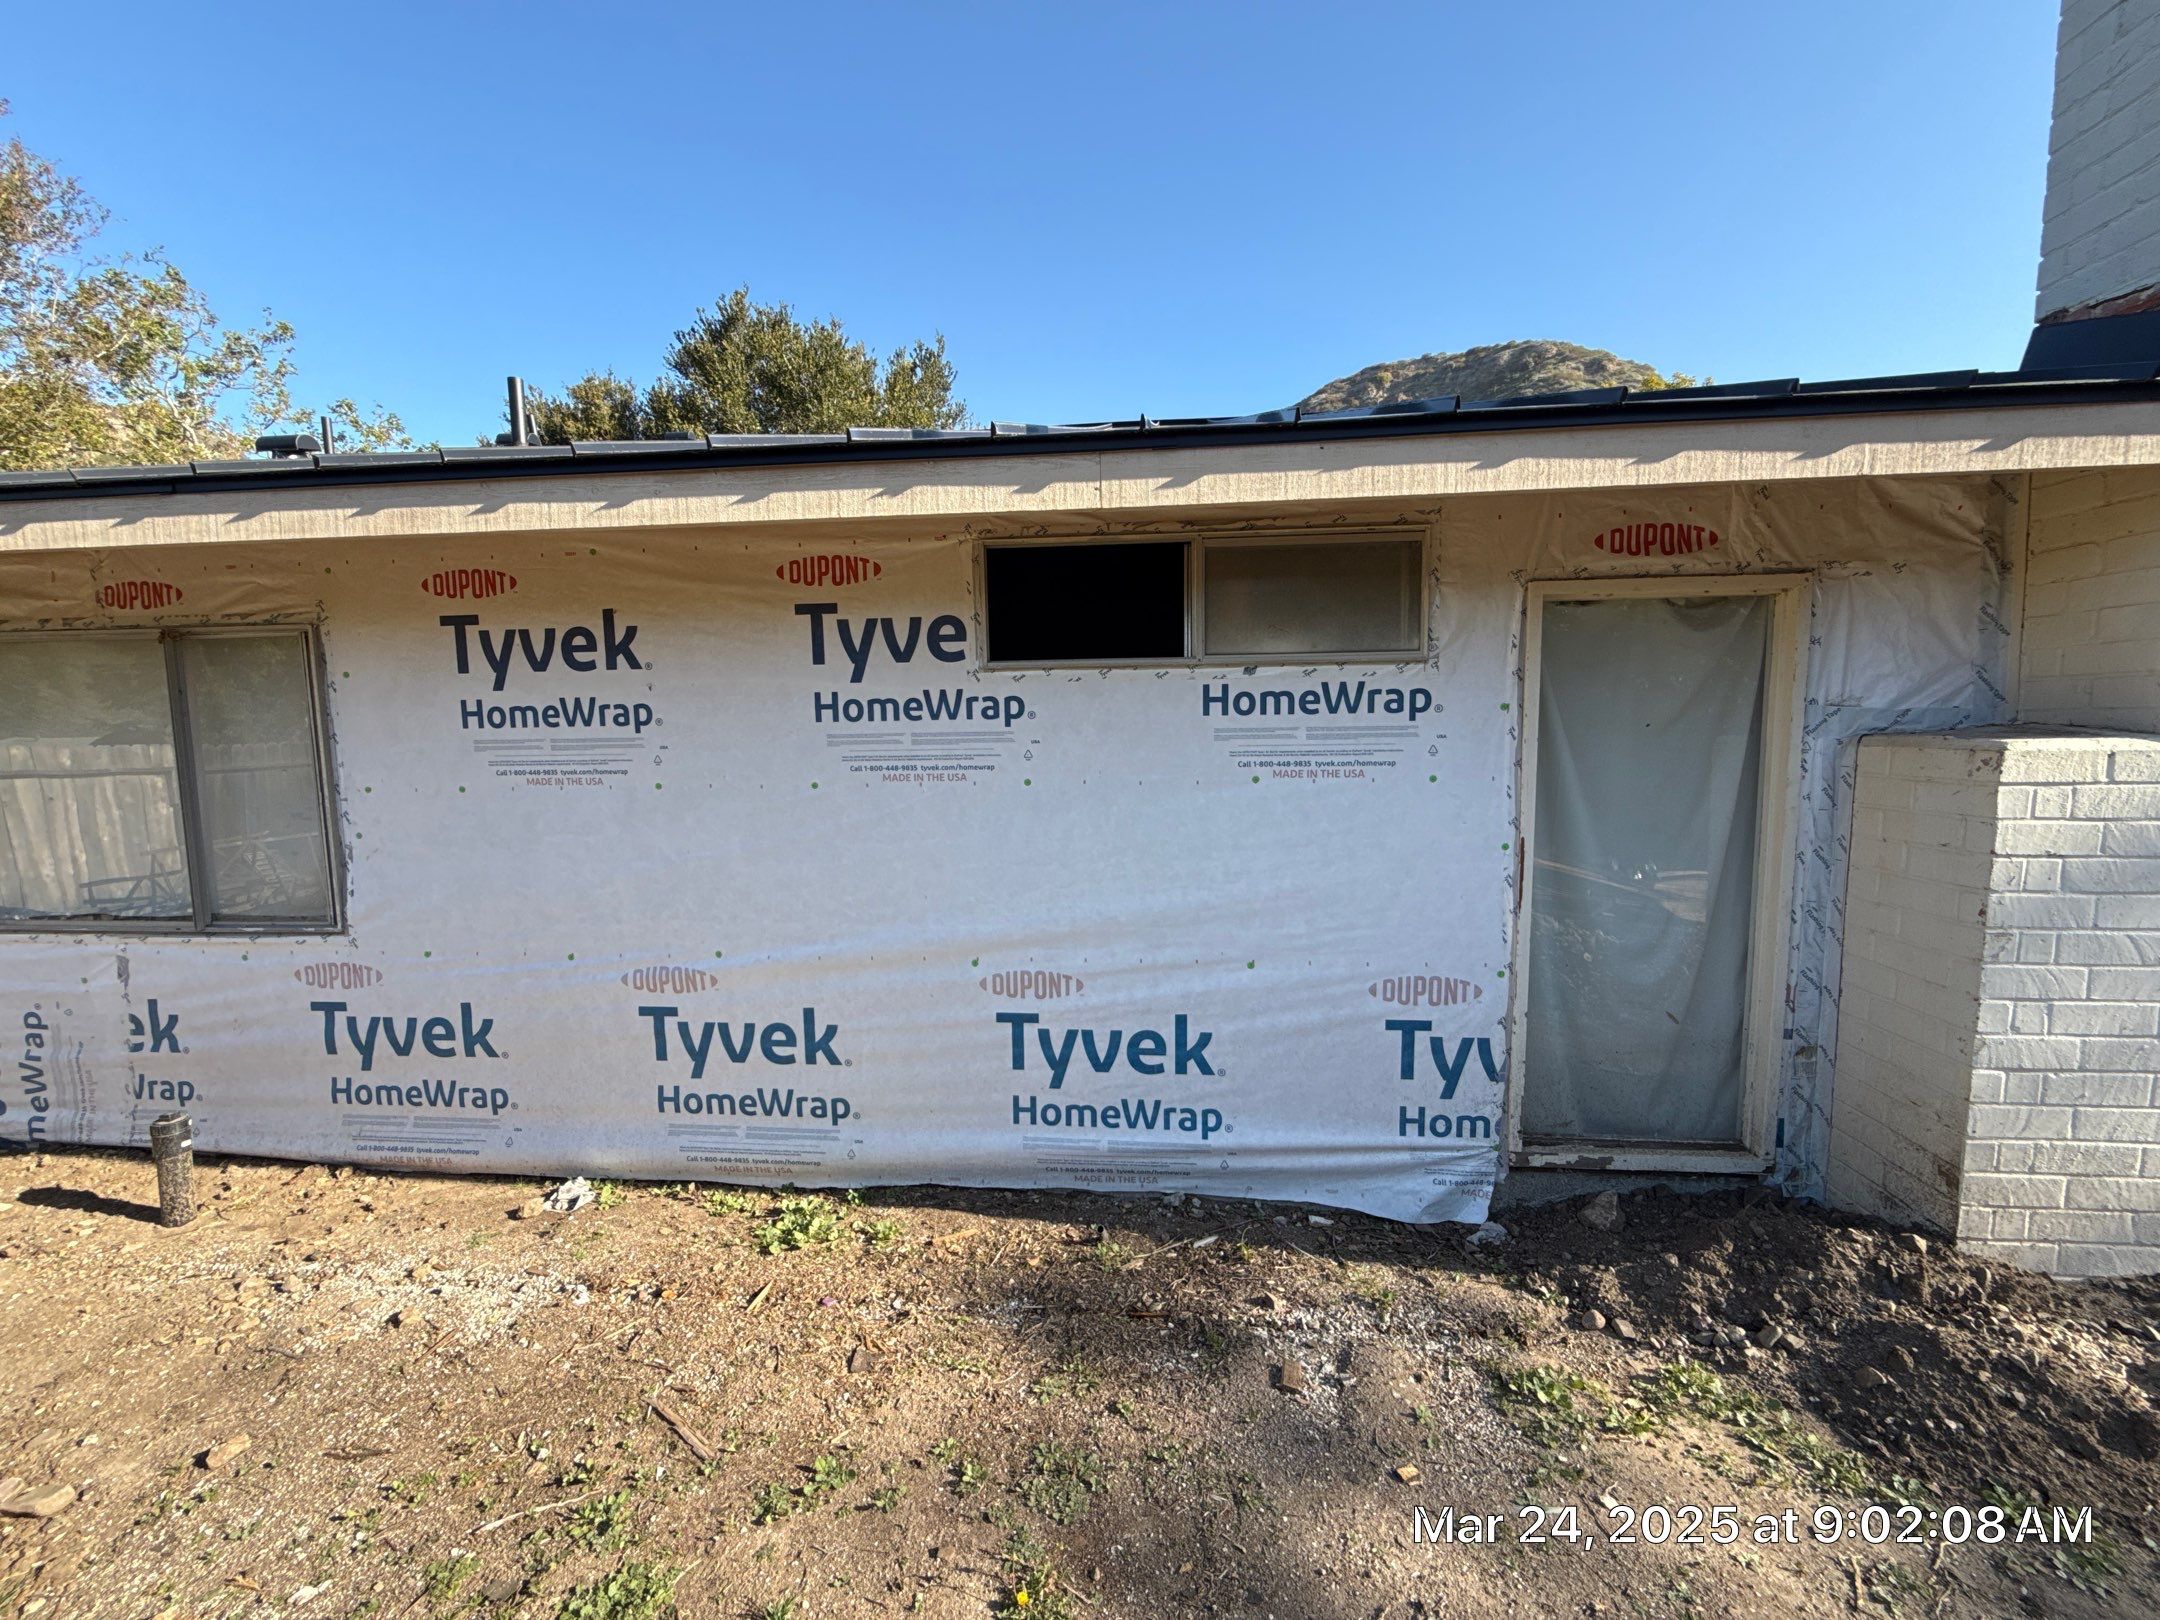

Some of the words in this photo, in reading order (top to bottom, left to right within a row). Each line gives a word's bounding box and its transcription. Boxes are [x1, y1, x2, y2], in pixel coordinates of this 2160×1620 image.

[1610, 522, 1705, 556] DUPONT
[432, 568, 506, 599] DUPONT
[789, 554, 870, 587] DUPONT
[104, 581, 174, 611] DUPONT
[439, 608, 643, 691] Tyvek
[460, 696, 653, 733] HomeWrap
[813, 688, 1025, 727] HomeWrap
[1202, 681, 1432, 721] HomeWrap
[526, 777, 553, 786] MADE
[554, 777, 564, 786] IN
[566, 777, 584, 786] THE
[585, 777, 604, 785] USA
[882, 774, 911, 782] MADE
[913, 773, 925, 782] IN
[926, 773, 945, 782] THE
[948, 773, 967, 782] USA
[1272, 769, 1304, 778] MADE
[1307, 769, 1318, 778] IN
[1320, 769, 1341, 778] THE
[1343, 769, 1365, 778] USA
[304, 962, 374, 990] DUPONT
[632, 966, 707, 994] DUPONT
[992, 970, 1073, 999] DUPONT
[1382, 975, 1470, 1006] DUPONT
[310, 1001, 500, 1071] Tyvek
[638, 1006, 843, 1079] Tyvek
[995, 1012, 1215, 1089] Tyvek
[330, 1076, 509, 1116] HomeWrap
[657, 1085, 851, 1126] HomeWrap
[1012, 1095, 1222, 1140] HomeWrap
[379, 1156, 404, 1164] MADE
[406, 1156, 416, 1164] IN
[417, 1156, 434, 1165] THE
[435, 1157, 452, 1165] USA
[714, 1165, 742, 1173] MADE
[742, 1165, 753, 1173] IN
[754, 1166, 773, 1174] THE
[774, 1166, 793, 1175] USA
[1105, 1175, 1116, 1183] IN
[1118, 1175, 1137, 1183] THE
[1139, 1176, 1159, 1184] USA
[1433, 1178, 1447, 1186] Call
[1462, 1188, 1491, 1199] MADE
